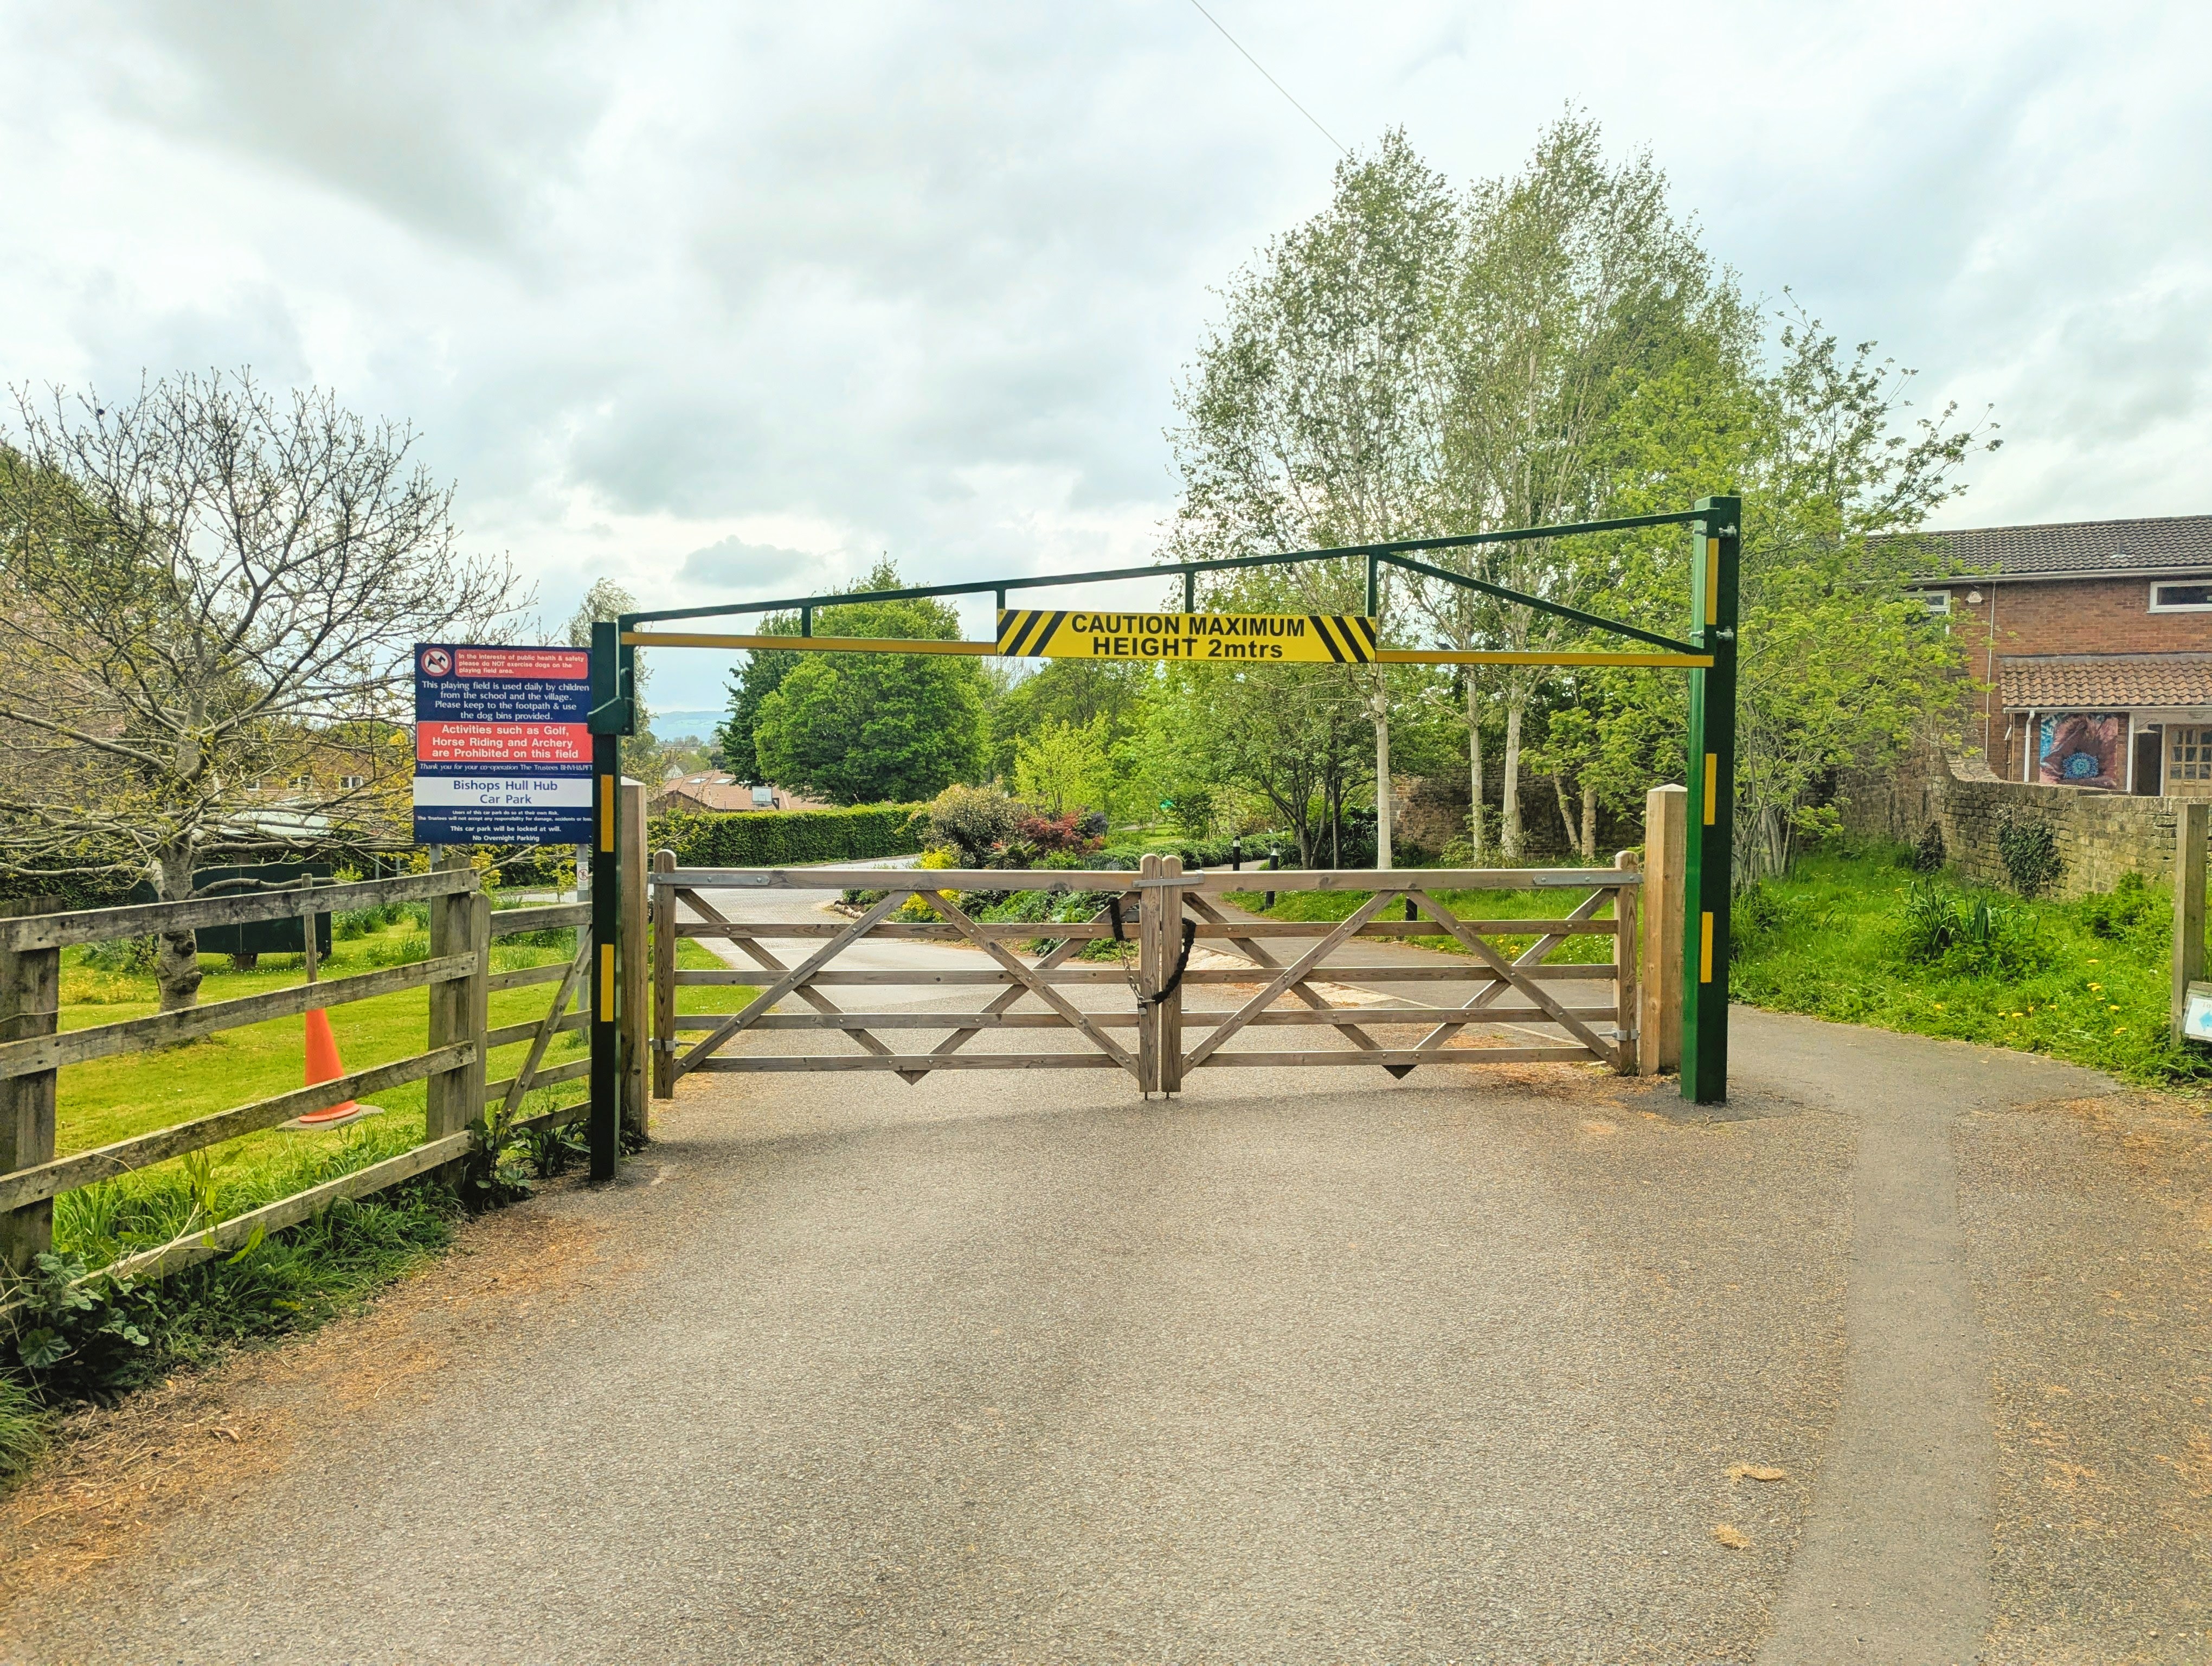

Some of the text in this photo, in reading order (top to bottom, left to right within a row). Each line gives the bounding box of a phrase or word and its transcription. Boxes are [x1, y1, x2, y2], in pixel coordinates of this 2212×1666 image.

[1071, 614, 1304, 637] CAUTION MAXIMUM
[1093, 637, 1283, 658] HEIGHT 2mtrs
[441, 681, 470, 691] playing
[524, 682, 543, 692] daily
[545, 683, 556, 692] by
[558, 683, 589, 691] children
[510, 692, 525, 700] and
[544, 693, 573, 702] village.
[435, 700, 461, 708] Please
[464, 701, 484, 710] keep
[516, 702, 551, 711] footpath
[477, 712, 493, 721] dog
[496, 712, 512, 720] bins
[515, 712, 553, 721] provided.
[441, 725, 492, 734] Activities
[497, 725, 522, 734] such
[544, 726, 569, 736] Golf,
[432, 736, 573, 748] Horse Riding and Archery
[454, 748, 509, 758] Prohibited
[531, 749, 551, 758] this
[555, 749, 578, 758] field
[454, 780, 558, 792] Bishops Hull Hub
[480, 794, 532, 804] Car Park
